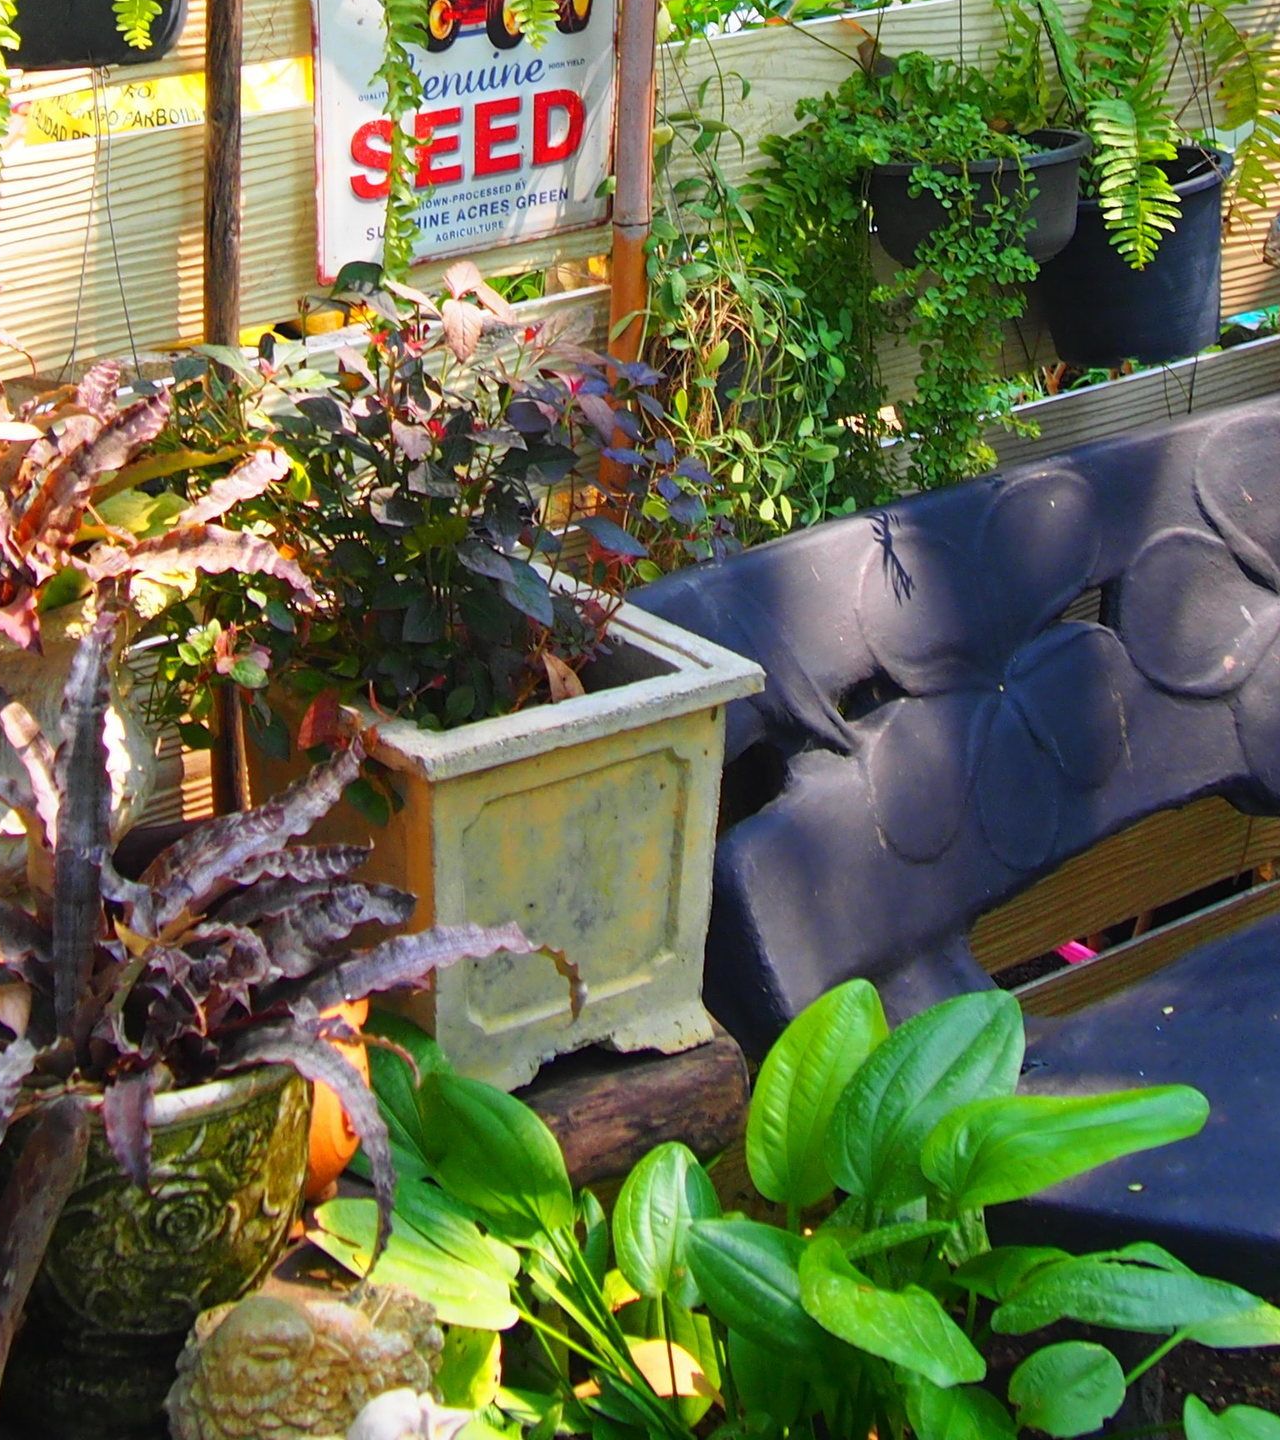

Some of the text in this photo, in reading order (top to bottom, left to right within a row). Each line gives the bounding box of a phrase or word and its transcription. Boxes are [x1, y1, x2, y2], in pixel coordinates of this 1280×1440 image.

[358, 90, 389, 102] QUALIT
[350, 89, 587, 201] SEED
[419, 179, 527, 210] OWN-PROCESSED BY
[366, 187, 569, 240] SUHINE ACRES GREEN
[435, 220, 504, 242] AGRICULTURE
